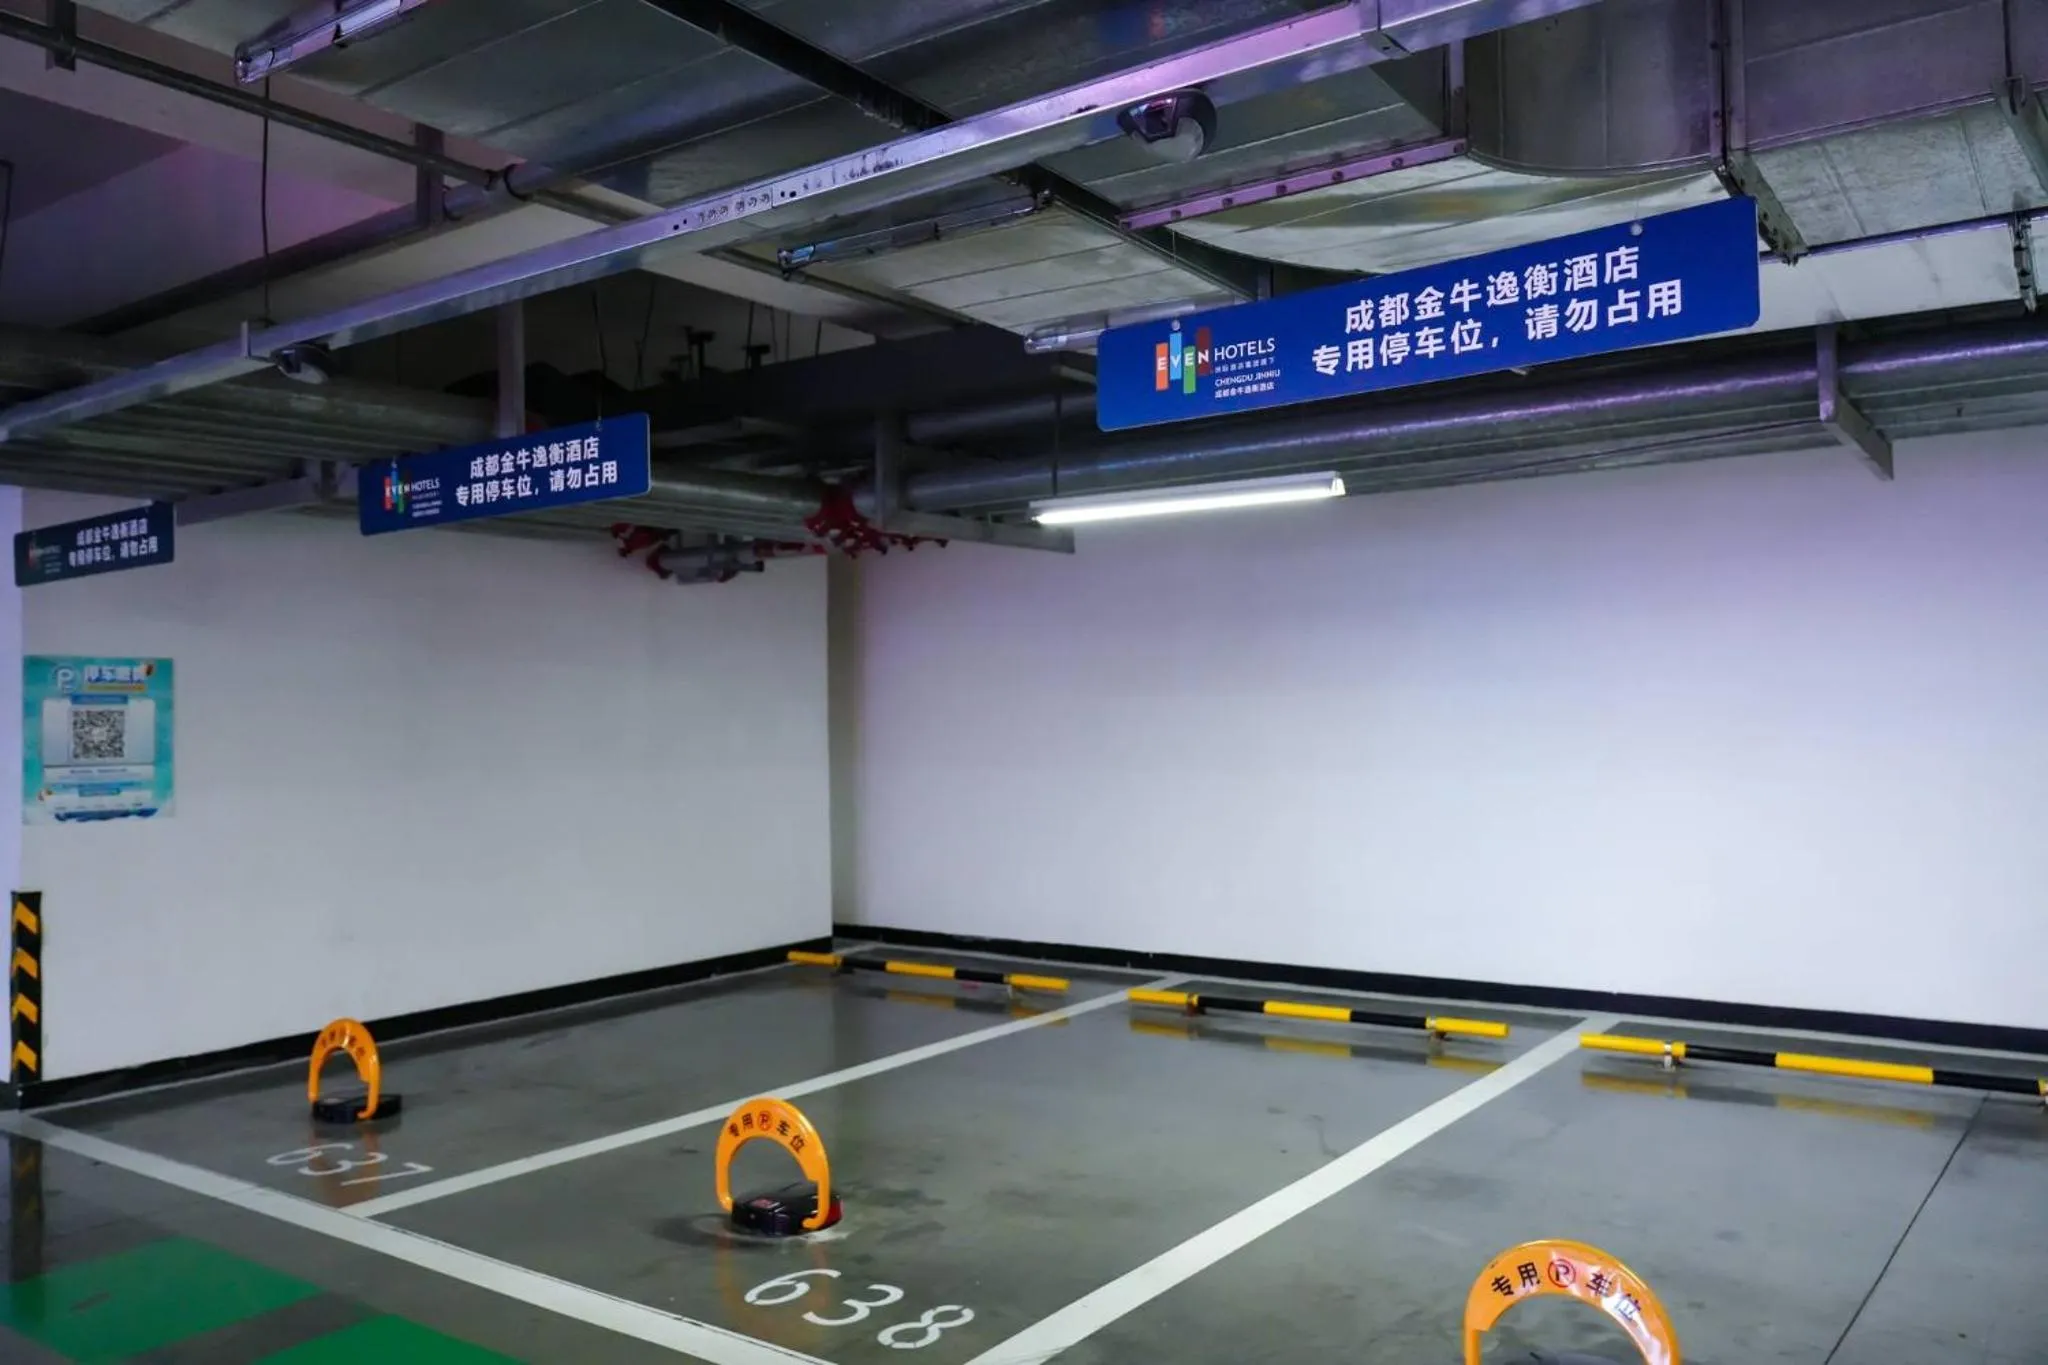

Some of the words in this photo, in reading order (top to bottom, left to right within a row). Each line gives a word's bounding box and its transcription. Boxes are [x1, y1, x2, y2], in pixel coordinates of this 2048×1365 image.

[1345, 246, 1640, 334] 成都金牛逸衡酒店
[1157, 349, 1210, 371] EVEN
[1214, 337, 1276, 361] HOTELS
[1214, 373, 1253, 387] CHENGDU
[470, 436, 600, 479] 成都金牛逸衡酒店
[411, 477, 440, 492] HOTELS
[744, 1268, 975, 1349] 638
